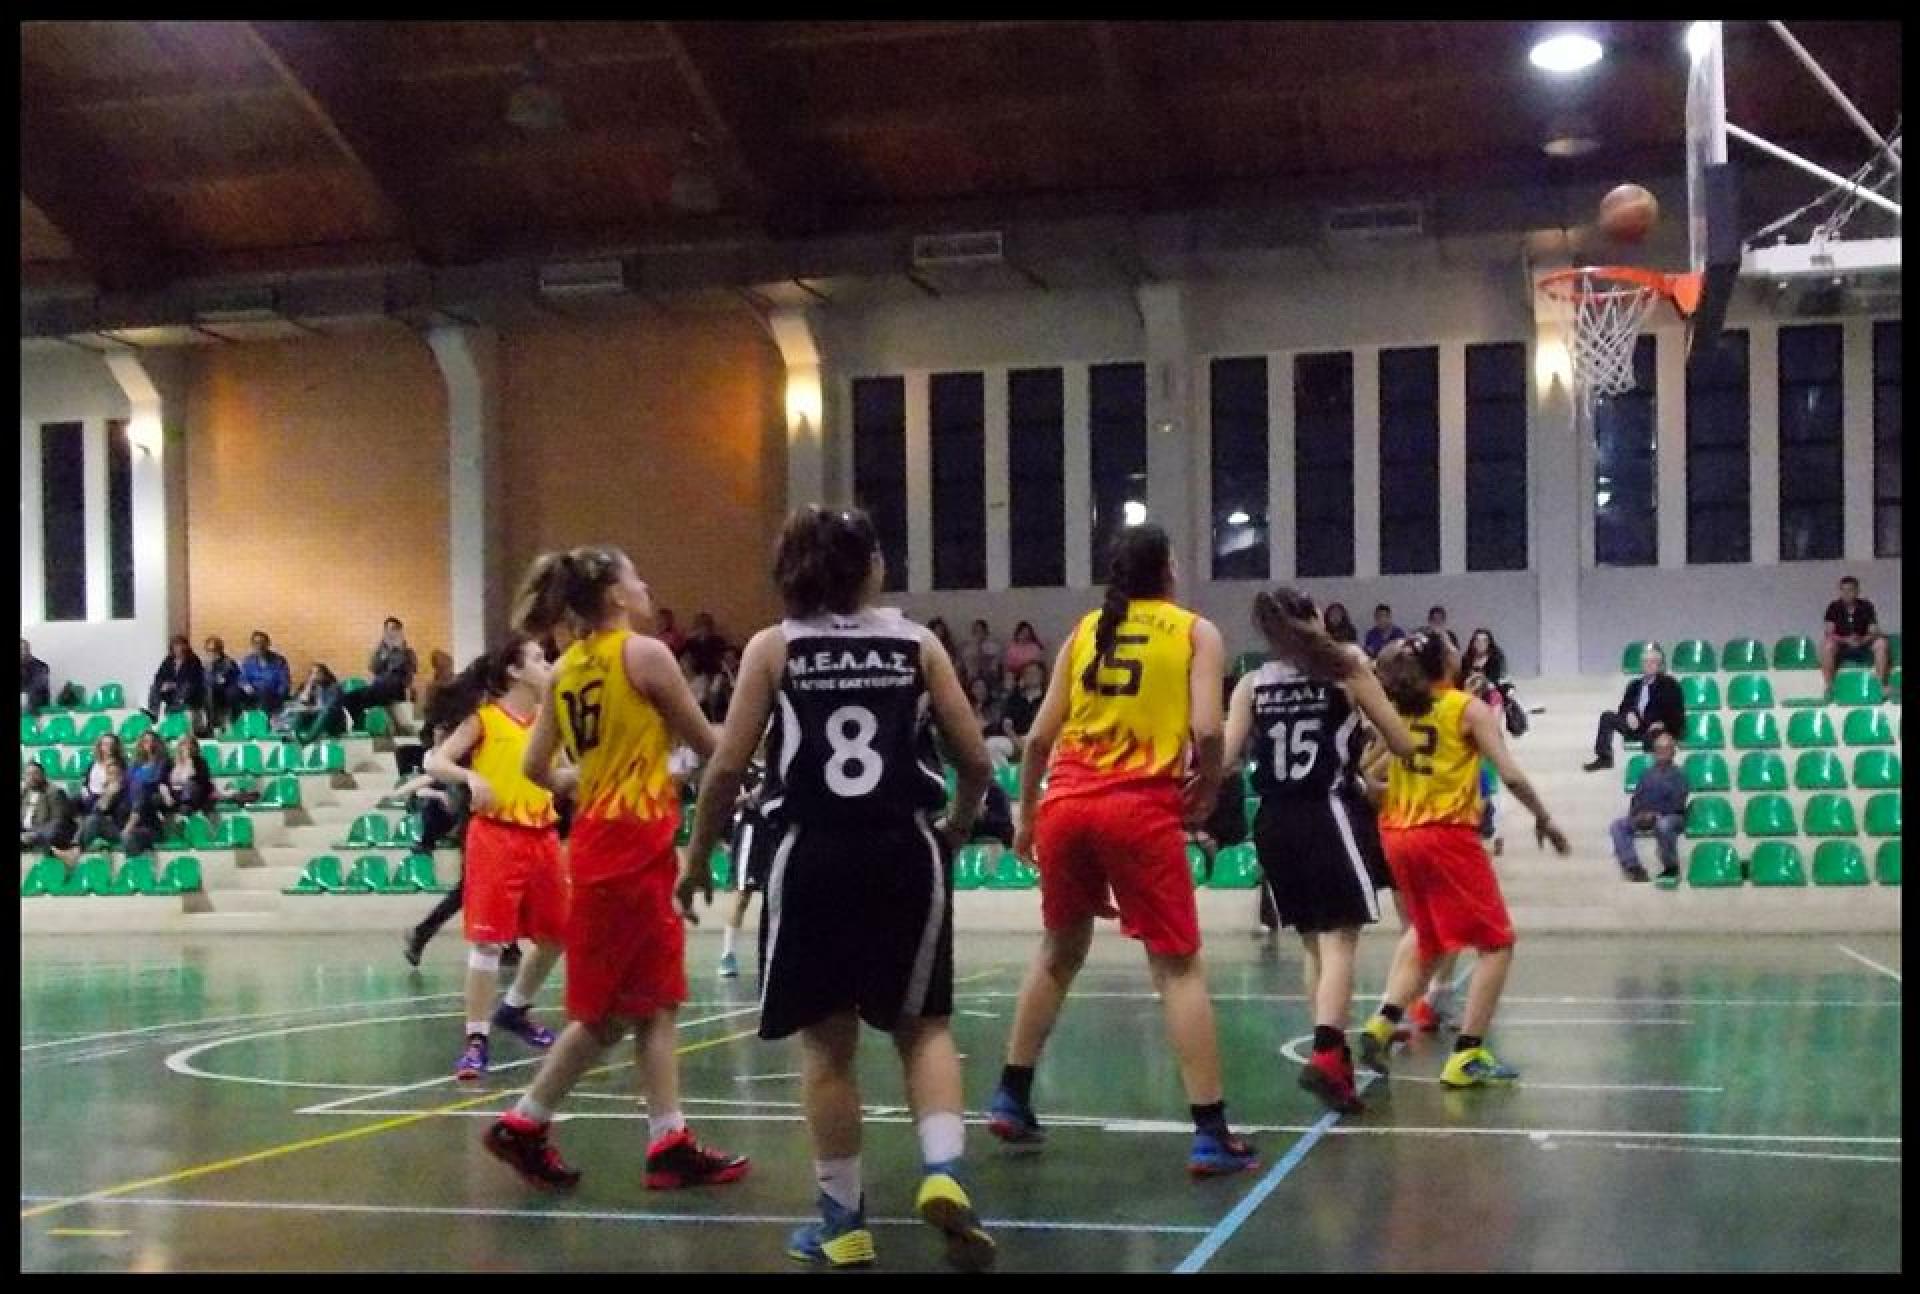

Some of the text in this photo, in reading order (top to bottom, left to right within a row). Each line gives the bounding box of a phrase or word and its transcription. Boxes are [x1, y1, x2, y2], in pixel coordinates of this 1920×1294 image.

[561, 678, 604, 757] 16
[825, 705, 883, 797] 8
[1267, 718, 1322, 781] 15
